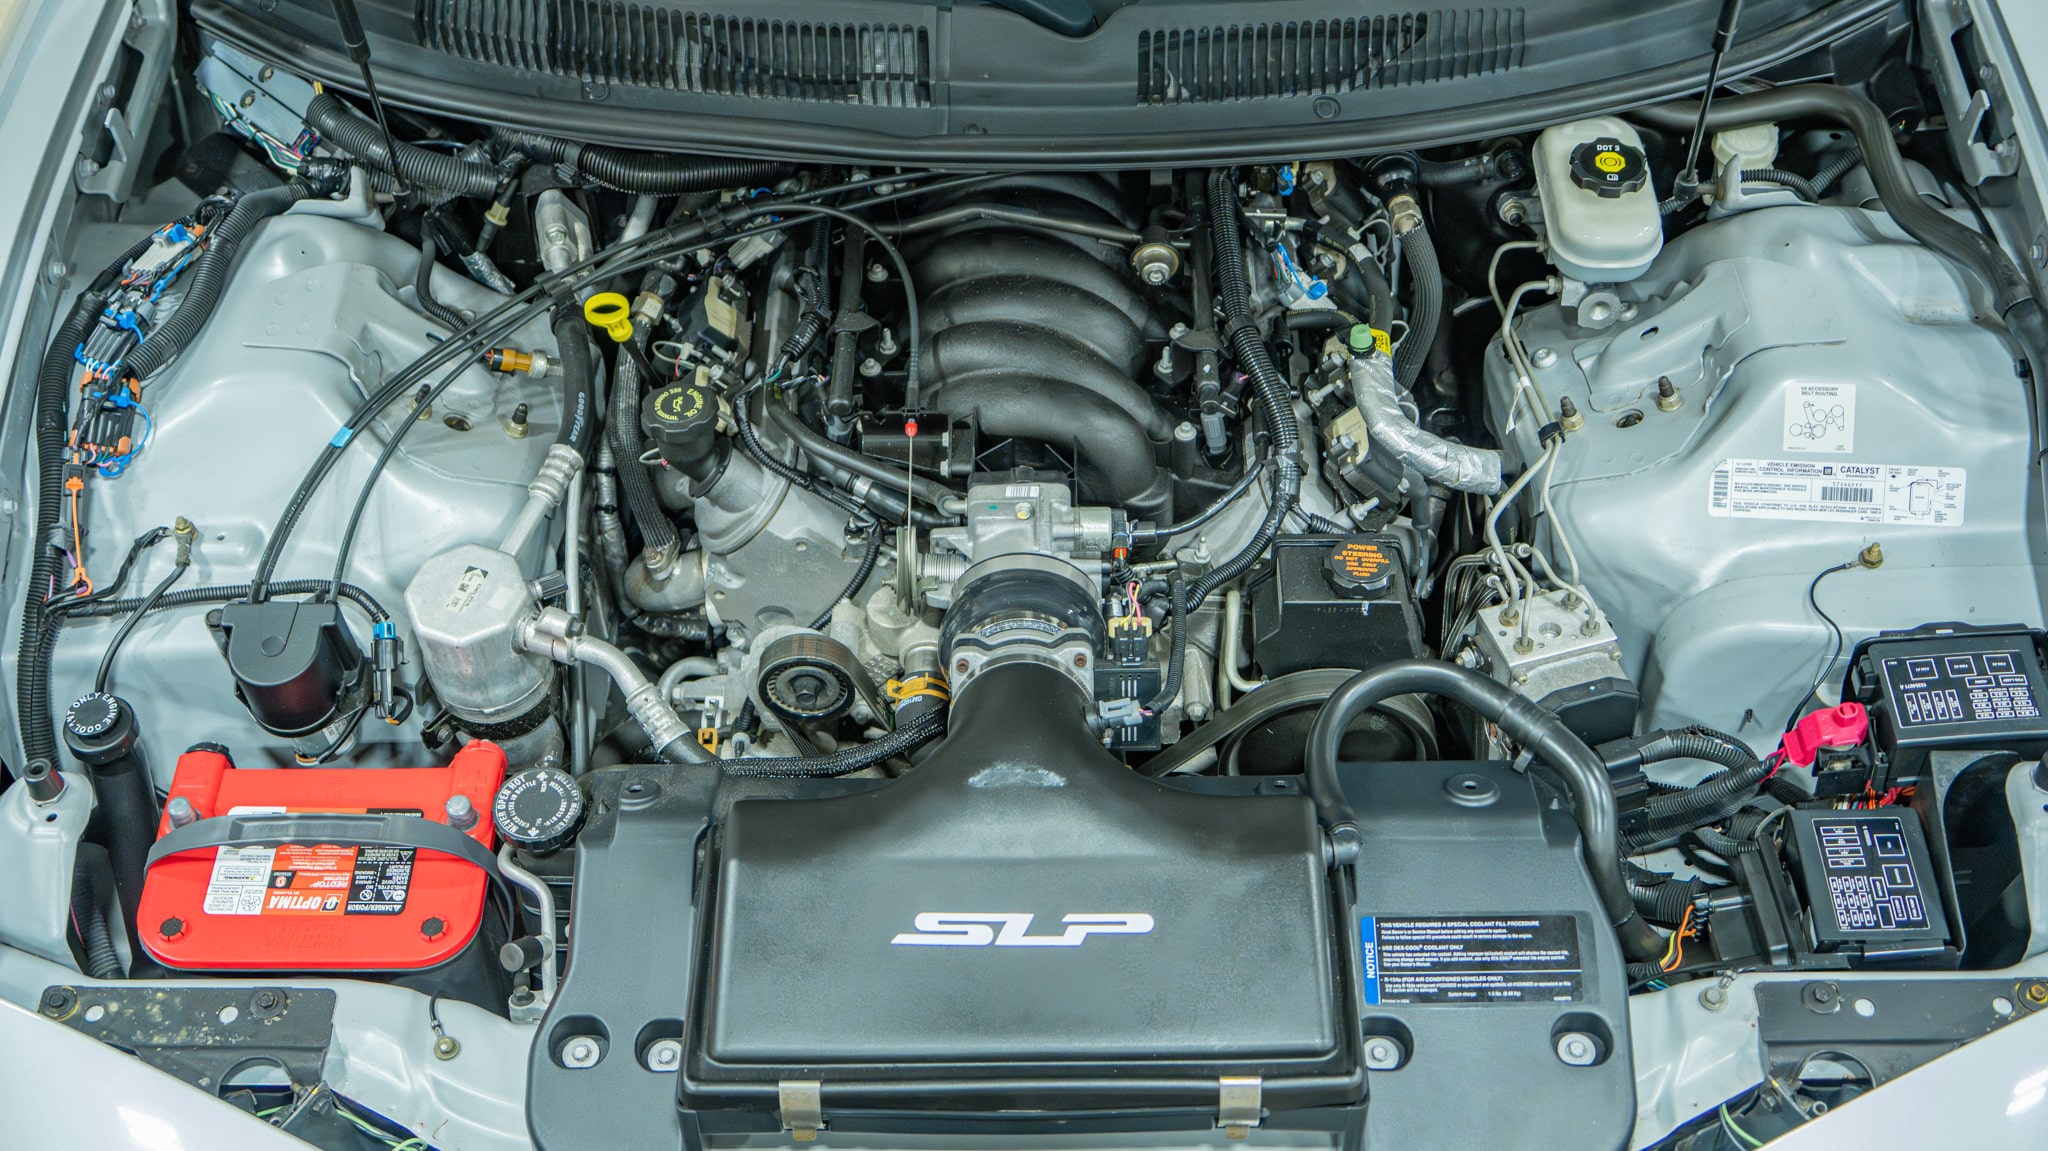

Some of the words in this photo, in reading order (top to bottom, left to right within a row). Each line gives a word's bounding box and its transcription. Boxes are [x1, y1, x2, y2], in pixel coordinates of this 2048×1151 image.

[686, 388, 704, 409] ENGINE
[570, 391, 585, 442] GOODYEAR
[683, 408, 698, 417] OIL
[1840, 466, 1880, 474] CATALYST
[1342, 550, 1382, 558] STEERING
[72, 692, 101, 708] ONLY
[102, 693, 118, 725] ENGINE
[508, 775, 526, 790] HOT
[515, 780, 536, 795] BOTTLE
[498, 788, 511, 810] OPEN
[498, 811, 519, 833] NEVER
[512, 815, 530, 828] CHECK
[269, 896, 322, 910] OPTIMA
[891, 912, 1155, 946] SLP
[1365, 942, 1376, 979] NOTICE
